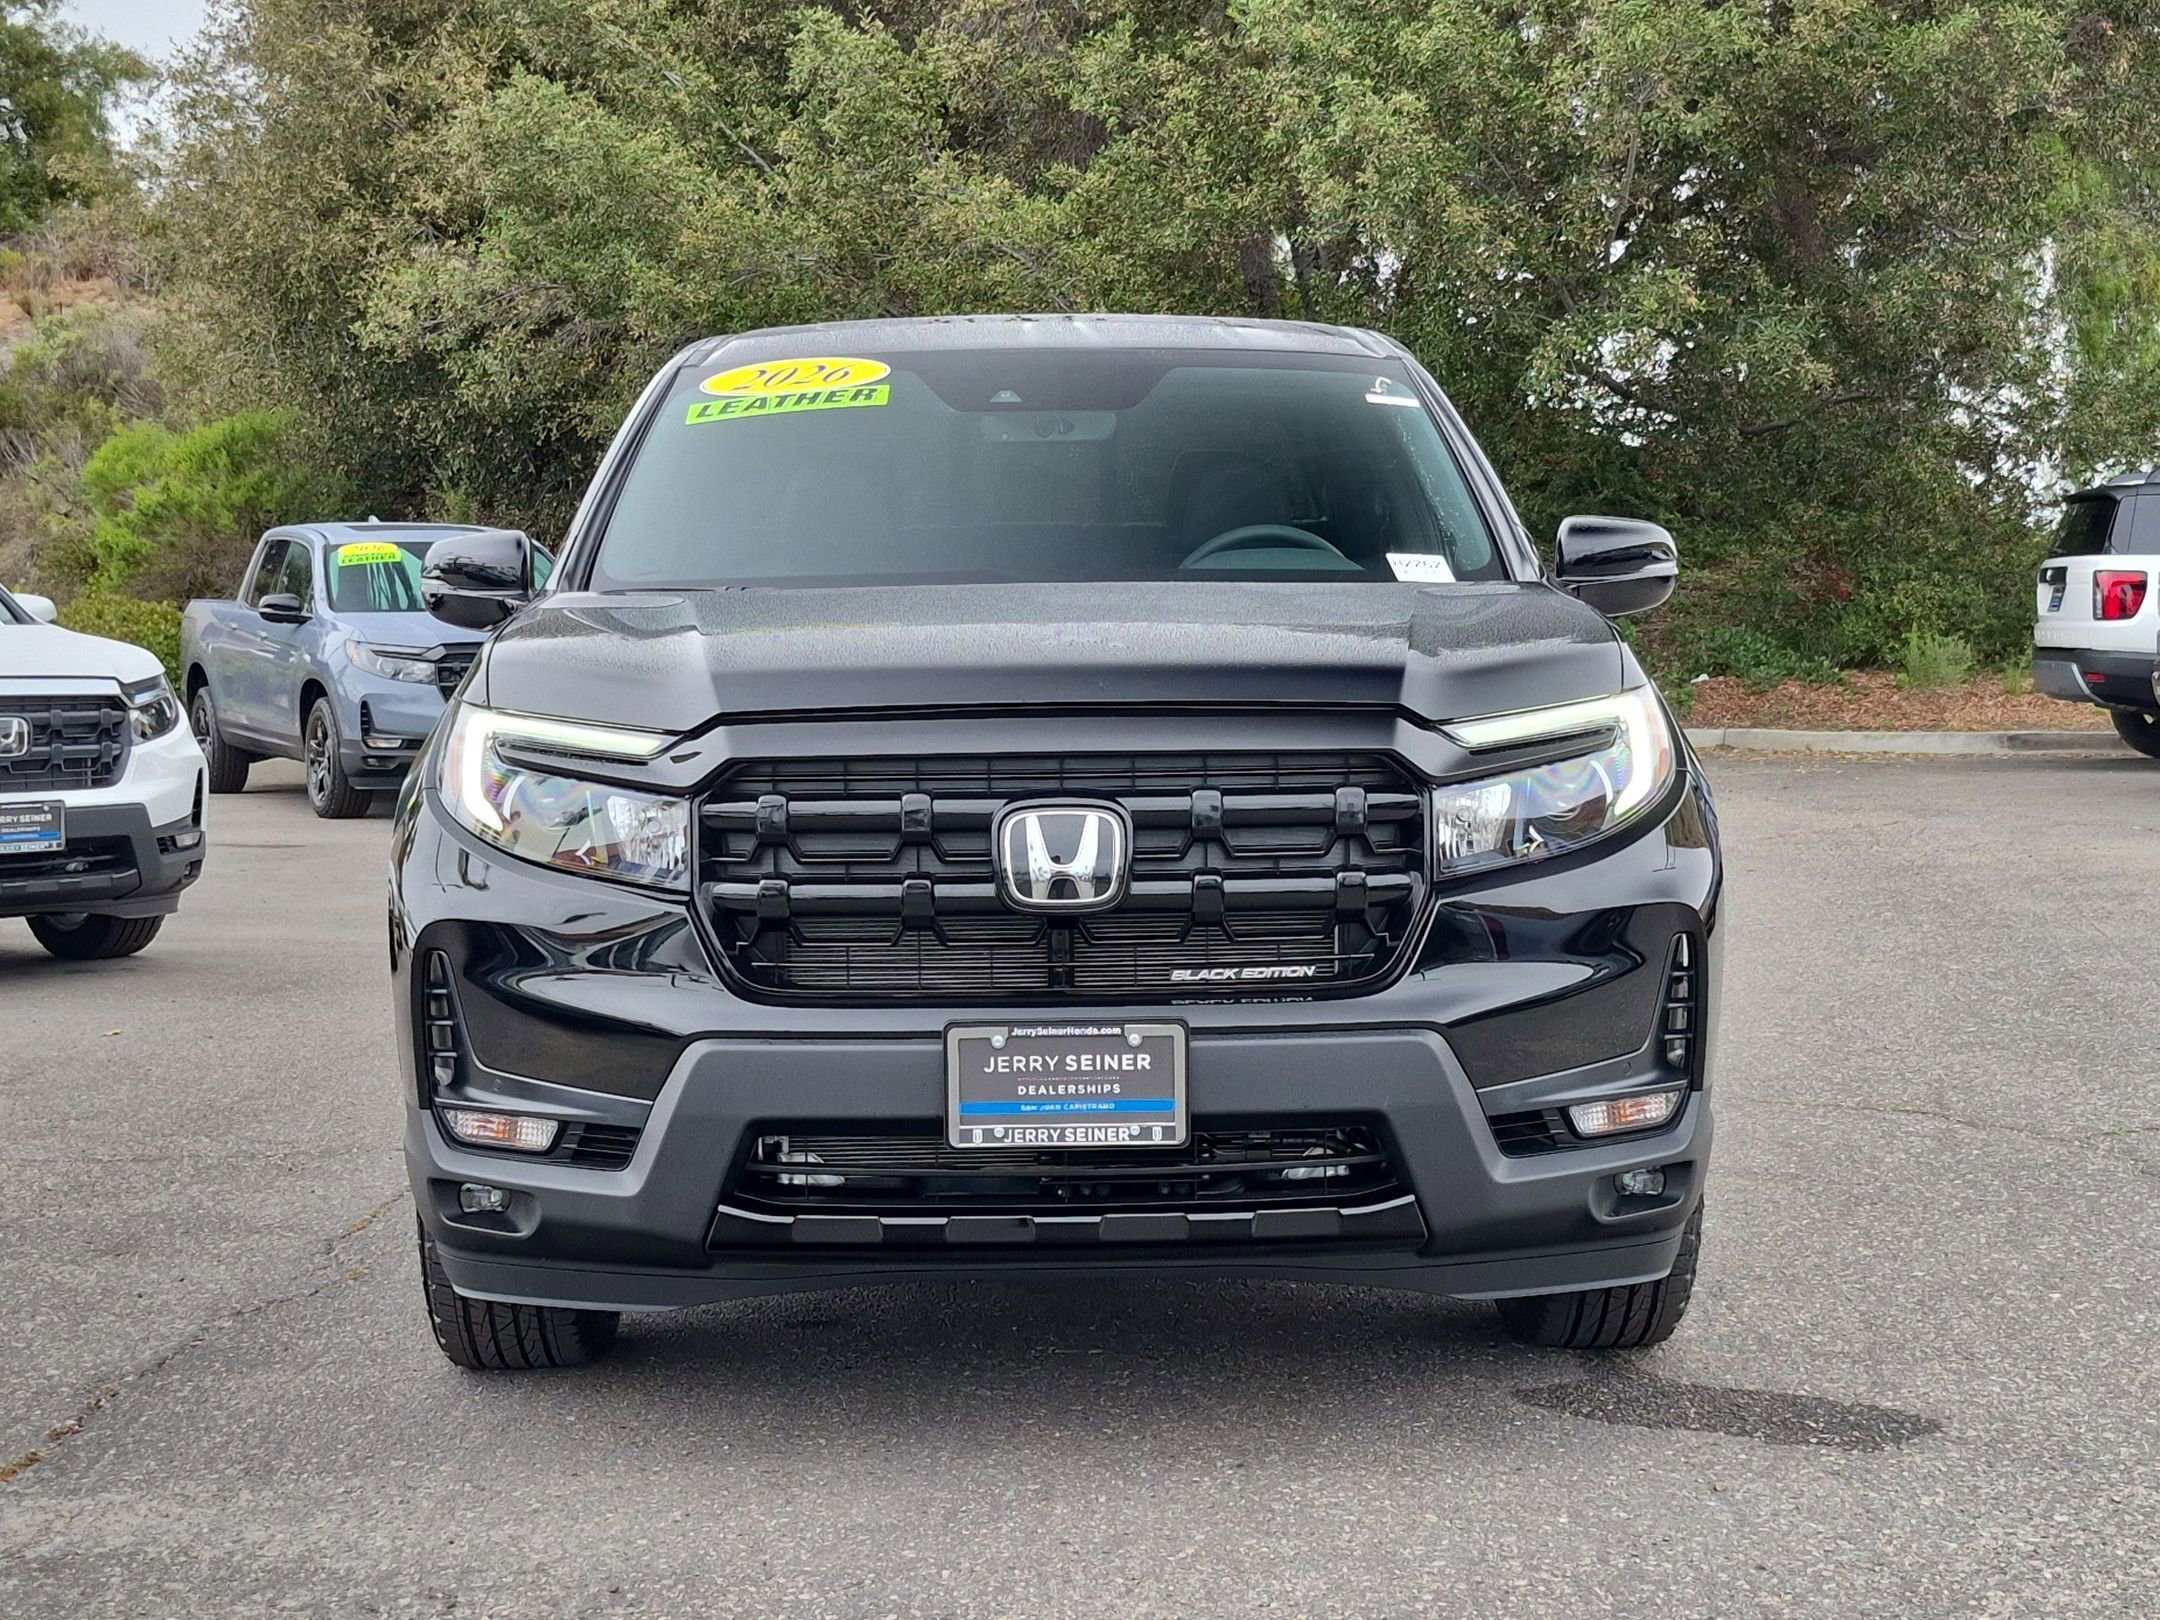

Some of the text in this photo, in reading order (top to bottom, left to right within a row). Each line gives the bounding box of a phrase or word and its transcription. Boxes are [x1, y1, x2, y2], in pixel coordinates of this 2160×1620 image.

[731, 364, 857, 391] 2026
[695, 387, 879, 419] LEATHER
[1171, 966, 1316, 981] BLACK EDITION
[1011, 1026, 1122, 1038] JerrySeinerHonda.com
[984, 1053, 1151, 1073] JERRY SEINER
[1017, 1083, 1121, 1096] DEALERSHIPS
[1040, 1103, 1061, 1111] JUAN
[1004, 1126, 1130, 1143] JERRY SEINER
